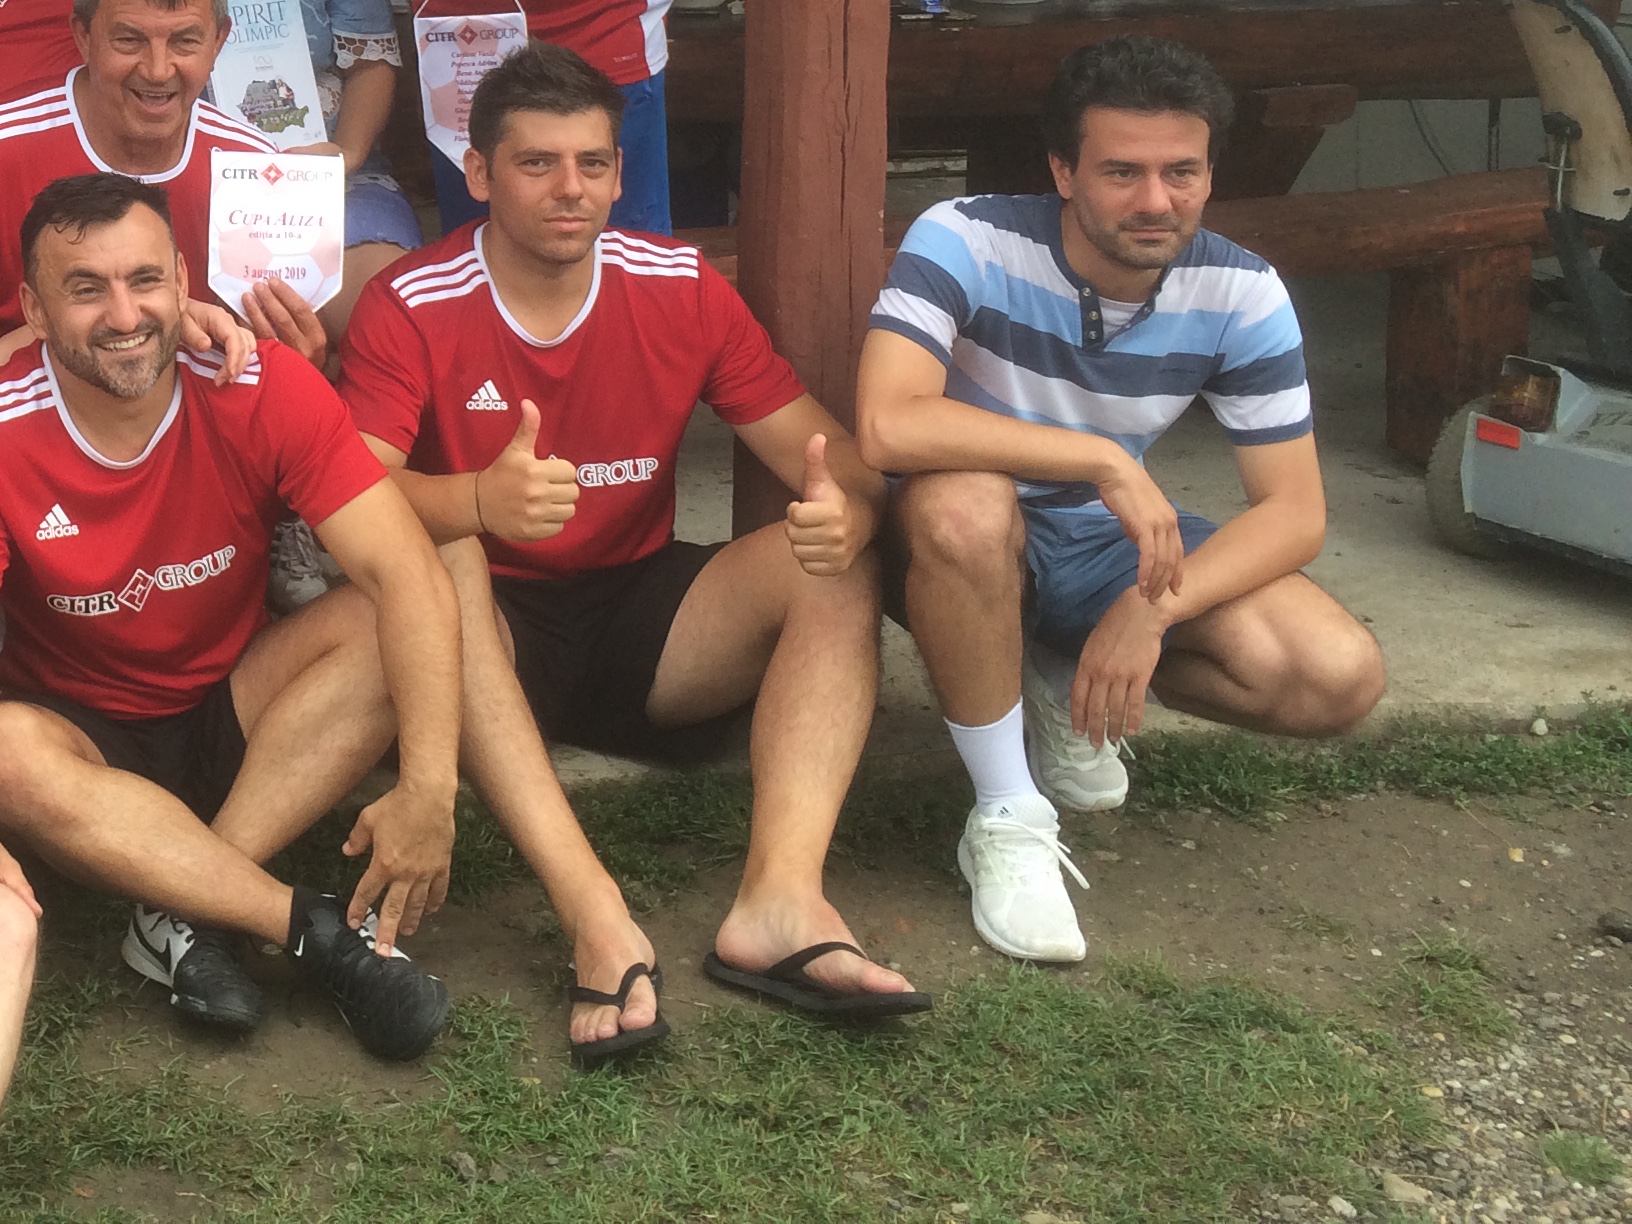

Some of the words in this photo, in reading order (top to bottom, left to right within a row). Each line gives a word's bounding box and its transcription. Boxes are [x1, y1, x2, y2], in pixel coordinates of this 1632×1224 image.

[231, 0, 286, 26] PIRIT
[226, 23, 290, 45] OLIMPIC
[425, 31, 457, 43] CITR
[479, 27, 519, 40] GROUP
[221, 168, 259, 180] CITR
[243, 265, 249, 278] 3
[251, 269, 282, 280] august
[284, 267, 306, 280] 2019
[466, 398, 508, 411] adidas
[577, 457, 658, 487] GROUP
[36, 524, 79, 541] adidas
[47, 590, 119, 616] CITR
[154, 545, 236, 591] GROUP
